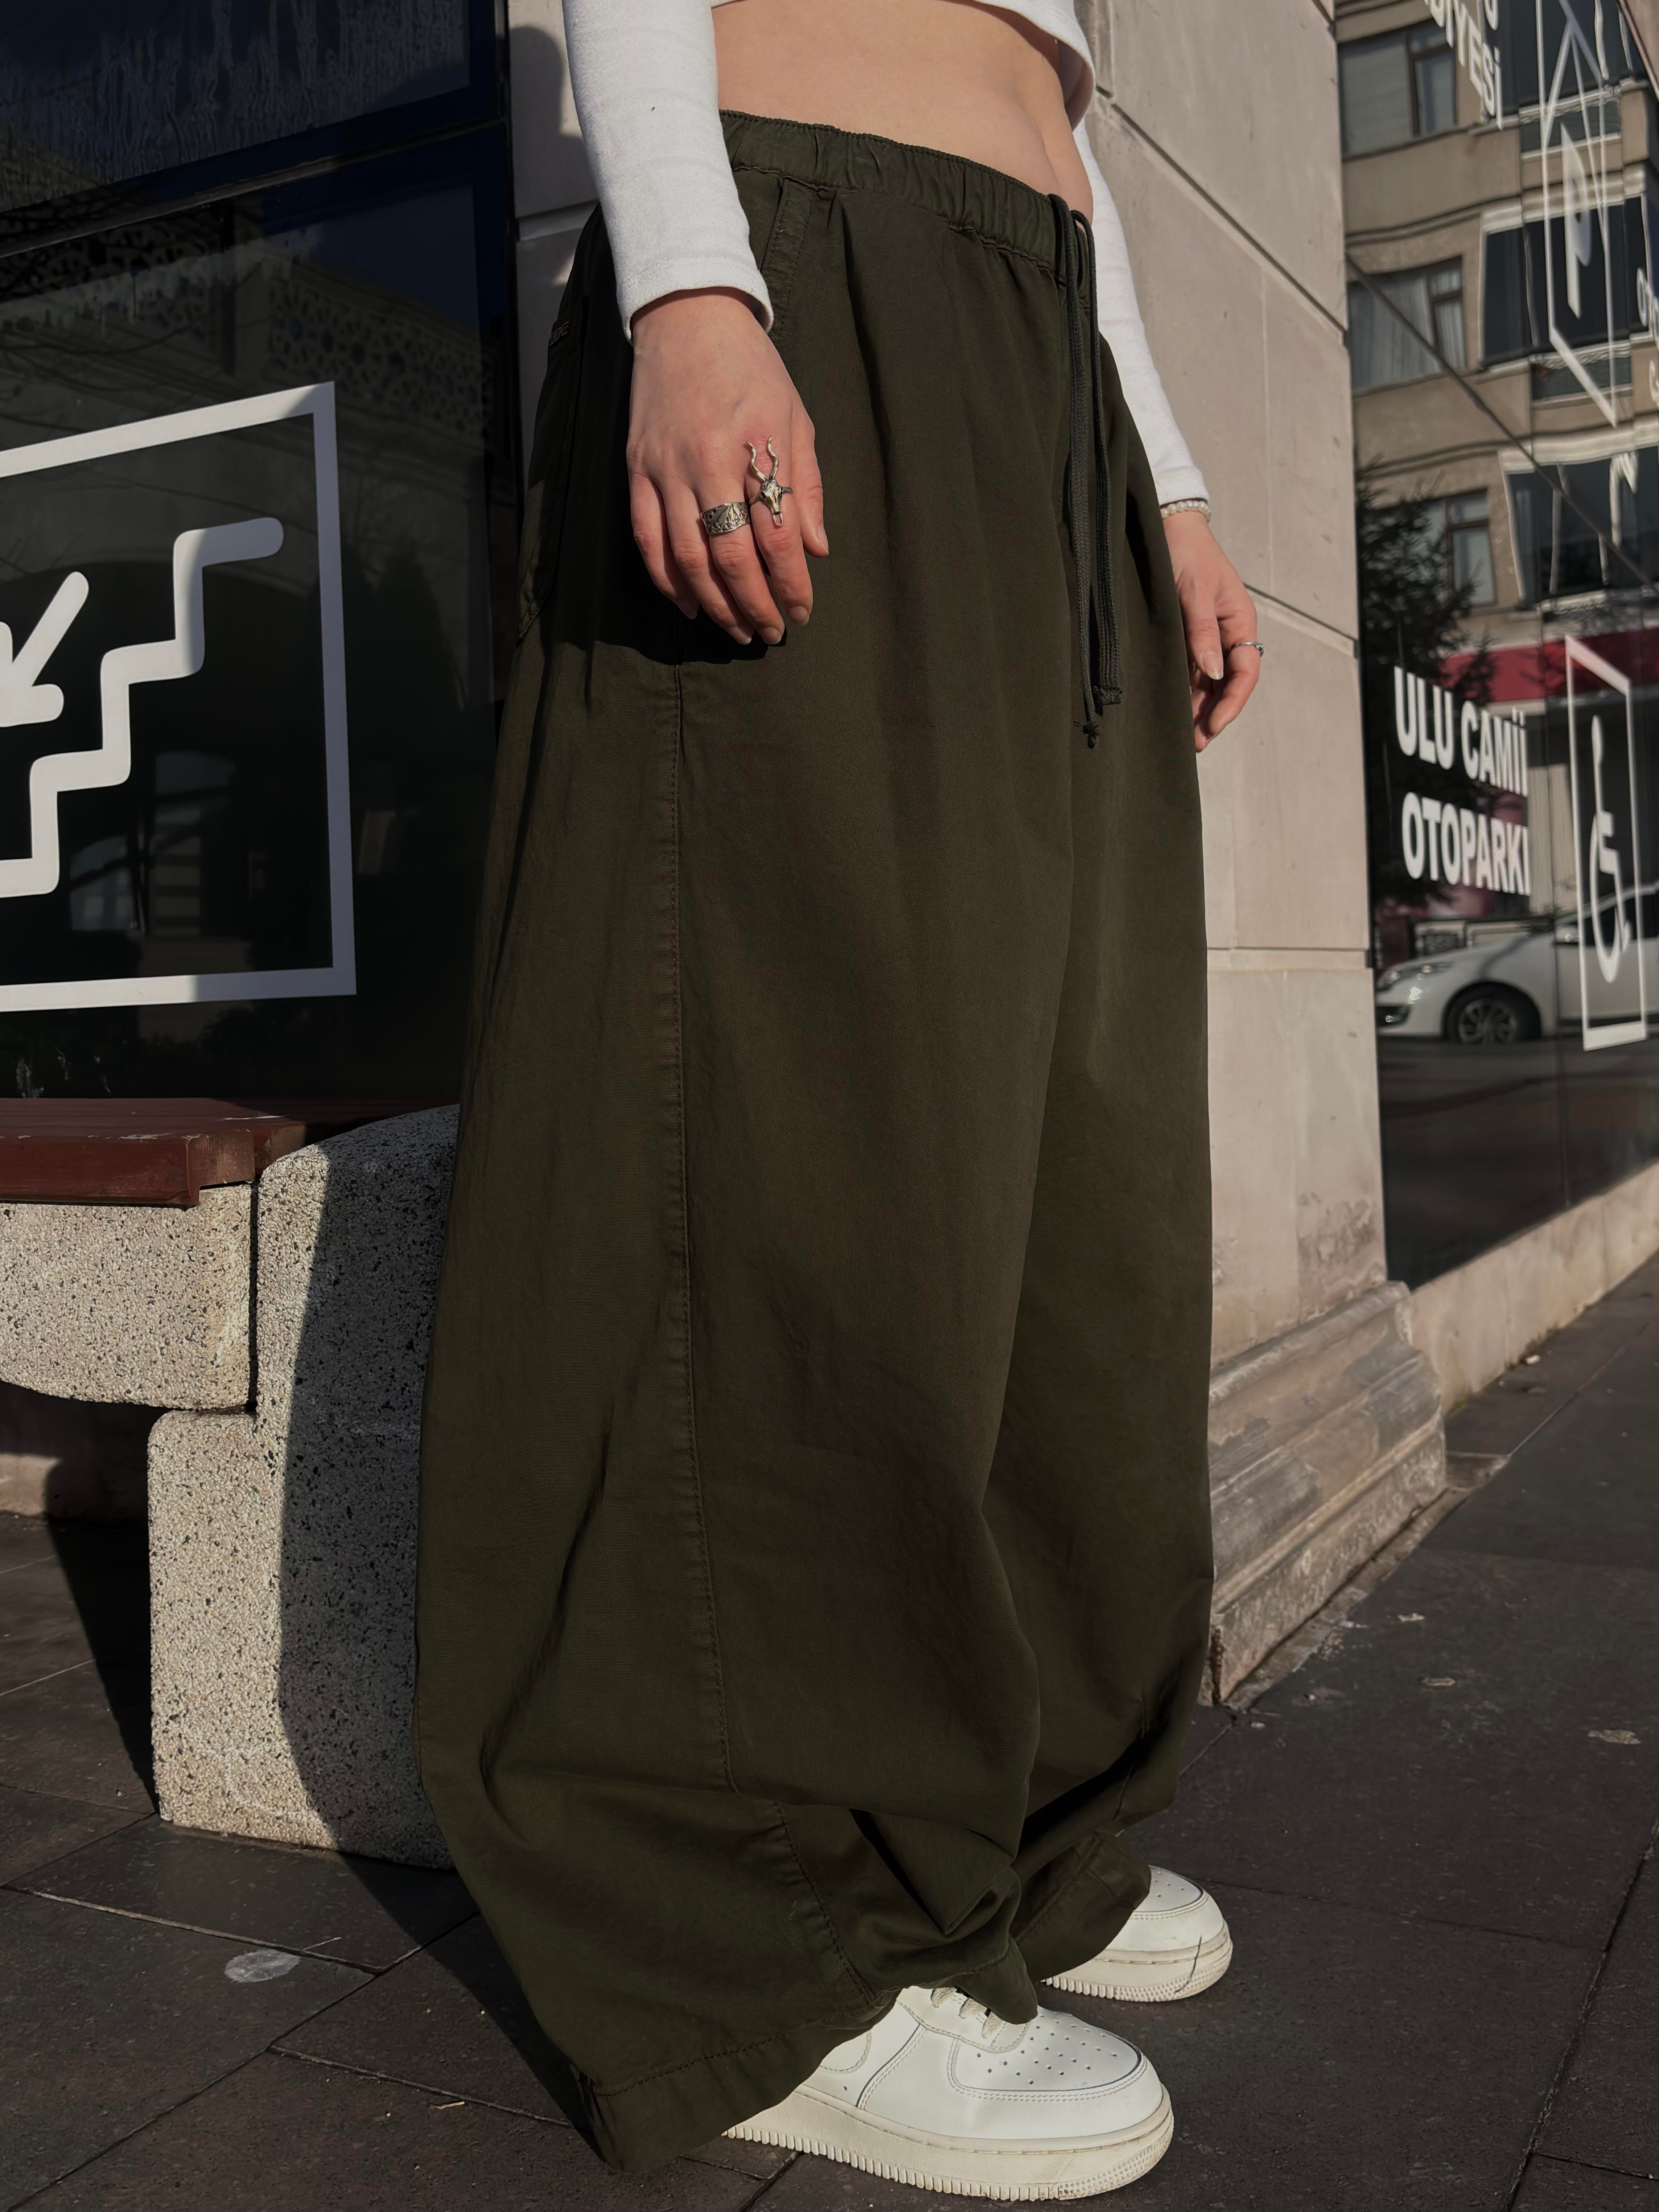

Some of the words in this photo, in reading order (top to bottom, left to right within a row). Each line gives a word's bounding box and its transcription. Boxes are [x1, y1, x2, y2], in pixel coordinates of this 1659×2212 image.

[1560, 122, 1592, 319] P
[1394, 665, 1454, 770] ULU
[1461, 700, 1528, 797] CAMİİ
[1402, 792, 1530, 896] OTOPARKI
